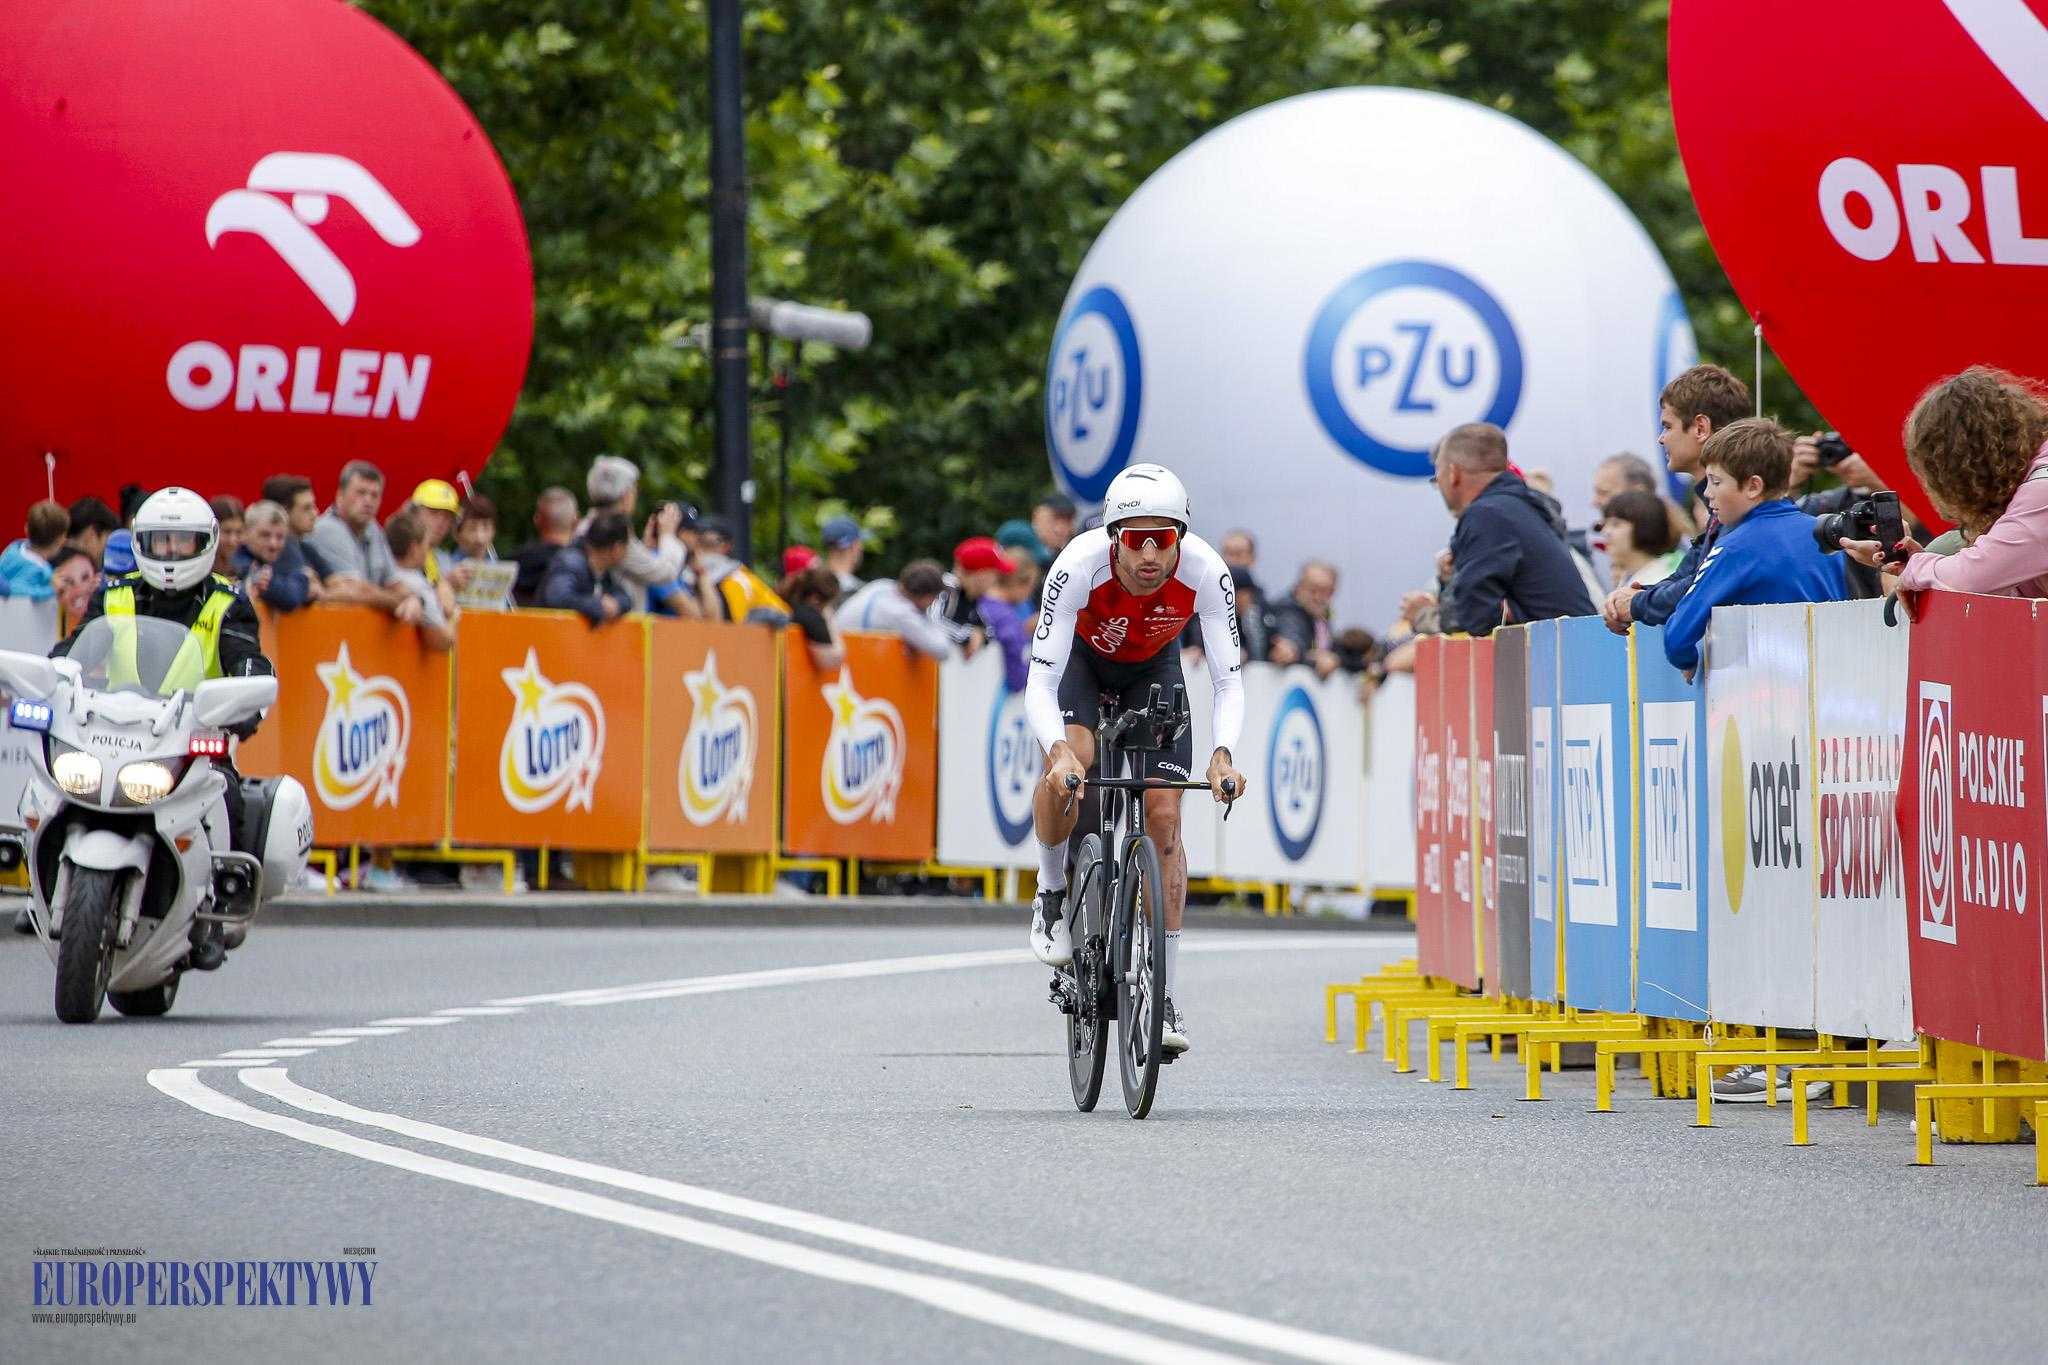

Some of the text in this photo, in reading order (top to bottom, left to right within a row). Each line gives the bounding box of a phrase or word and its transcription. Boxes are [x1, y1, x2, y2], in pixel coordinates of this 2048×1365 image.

[166, 340, 432, 420] ORLEN
[1055, 345, 1110, 440] PZU
[1357, 321, 1477, 412] PZU
[1036, 569, 1069, 641] Cofidis
[1219, 573, 1239, 648] Cofidis
[92, 735, 142, 751] POLICJA
[337, 710, 388, 773] LOTTO
[525, 715, 580, 776] LOTTO
[700, 724, 743, 788] LOTTO
[841, 727, 885, 791] LOTTO
[1959, 731, 2025, 808] POLSKIE
[1749, 734, 1801, 869] onet
[1960, 835, 2027, 915] RADIO
